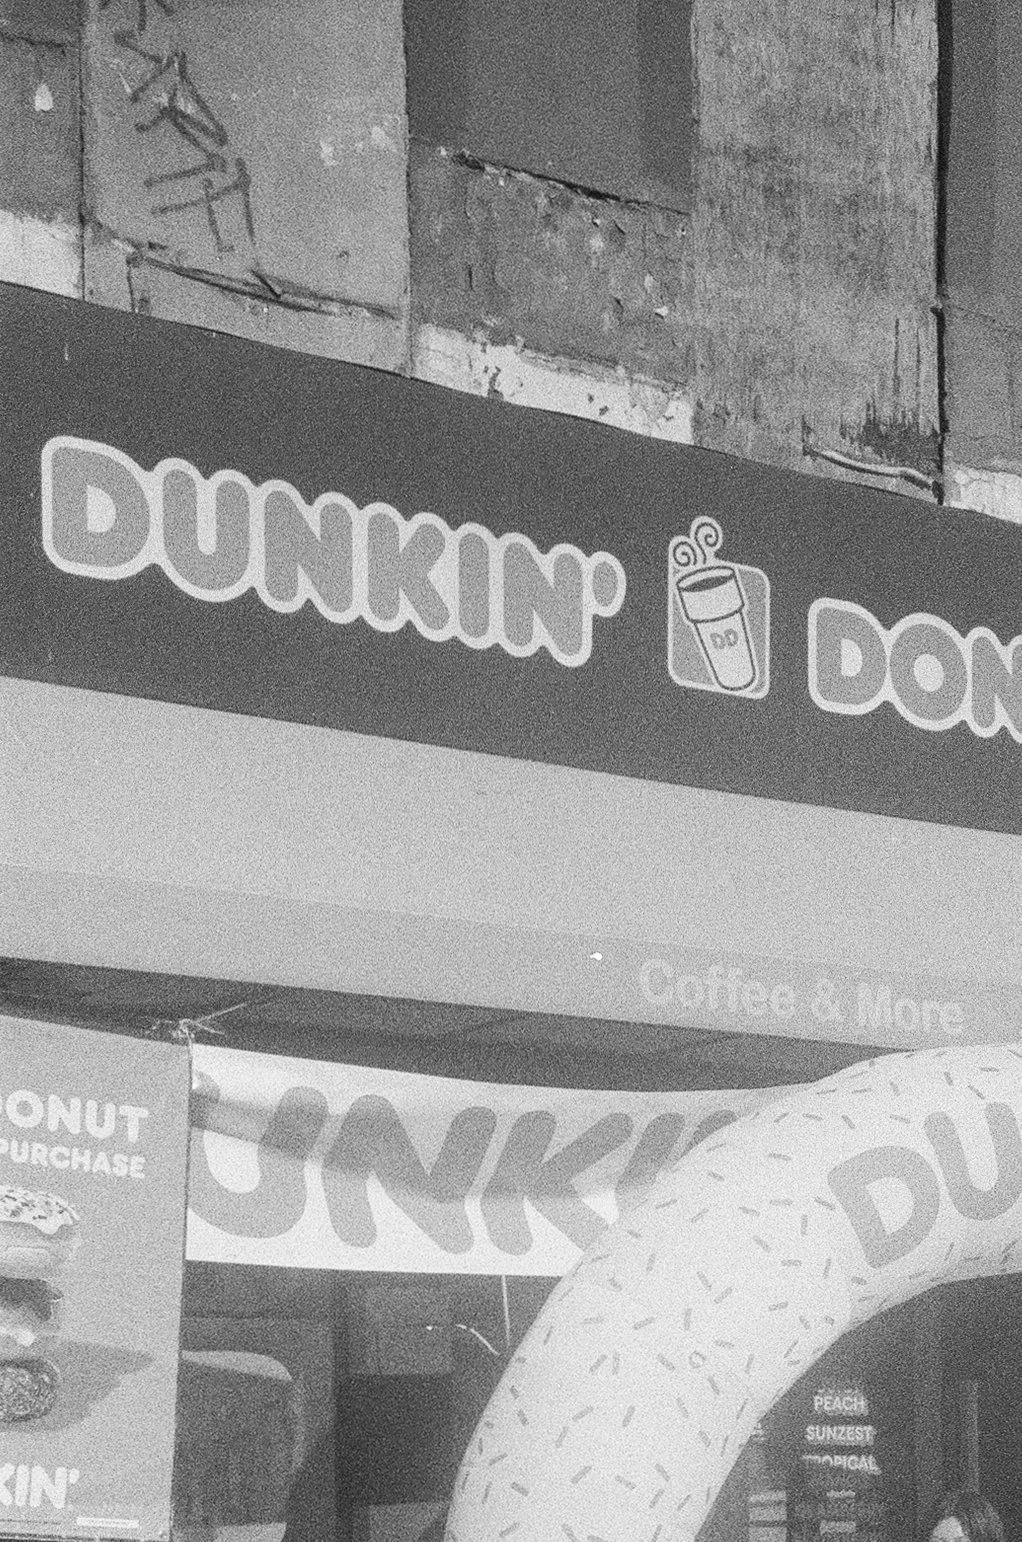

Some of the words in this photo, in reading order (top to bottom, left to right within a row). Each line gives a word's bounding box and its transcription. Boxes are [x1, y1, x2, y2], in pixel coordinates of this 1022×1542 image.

[41, 435, 626, 667] DUNKIN'
[709, 628, 739, 650] DD
[640, 958, 796, 1018] Coffee
[811, 977, 842, 1022] &
[856, 982, 966, 1036] More
[0, 1089, 149, 1144] ONUT
[814, 1395, 867, 1412] PEACH
[804, 1425, 875, 1442] SUNZEST
